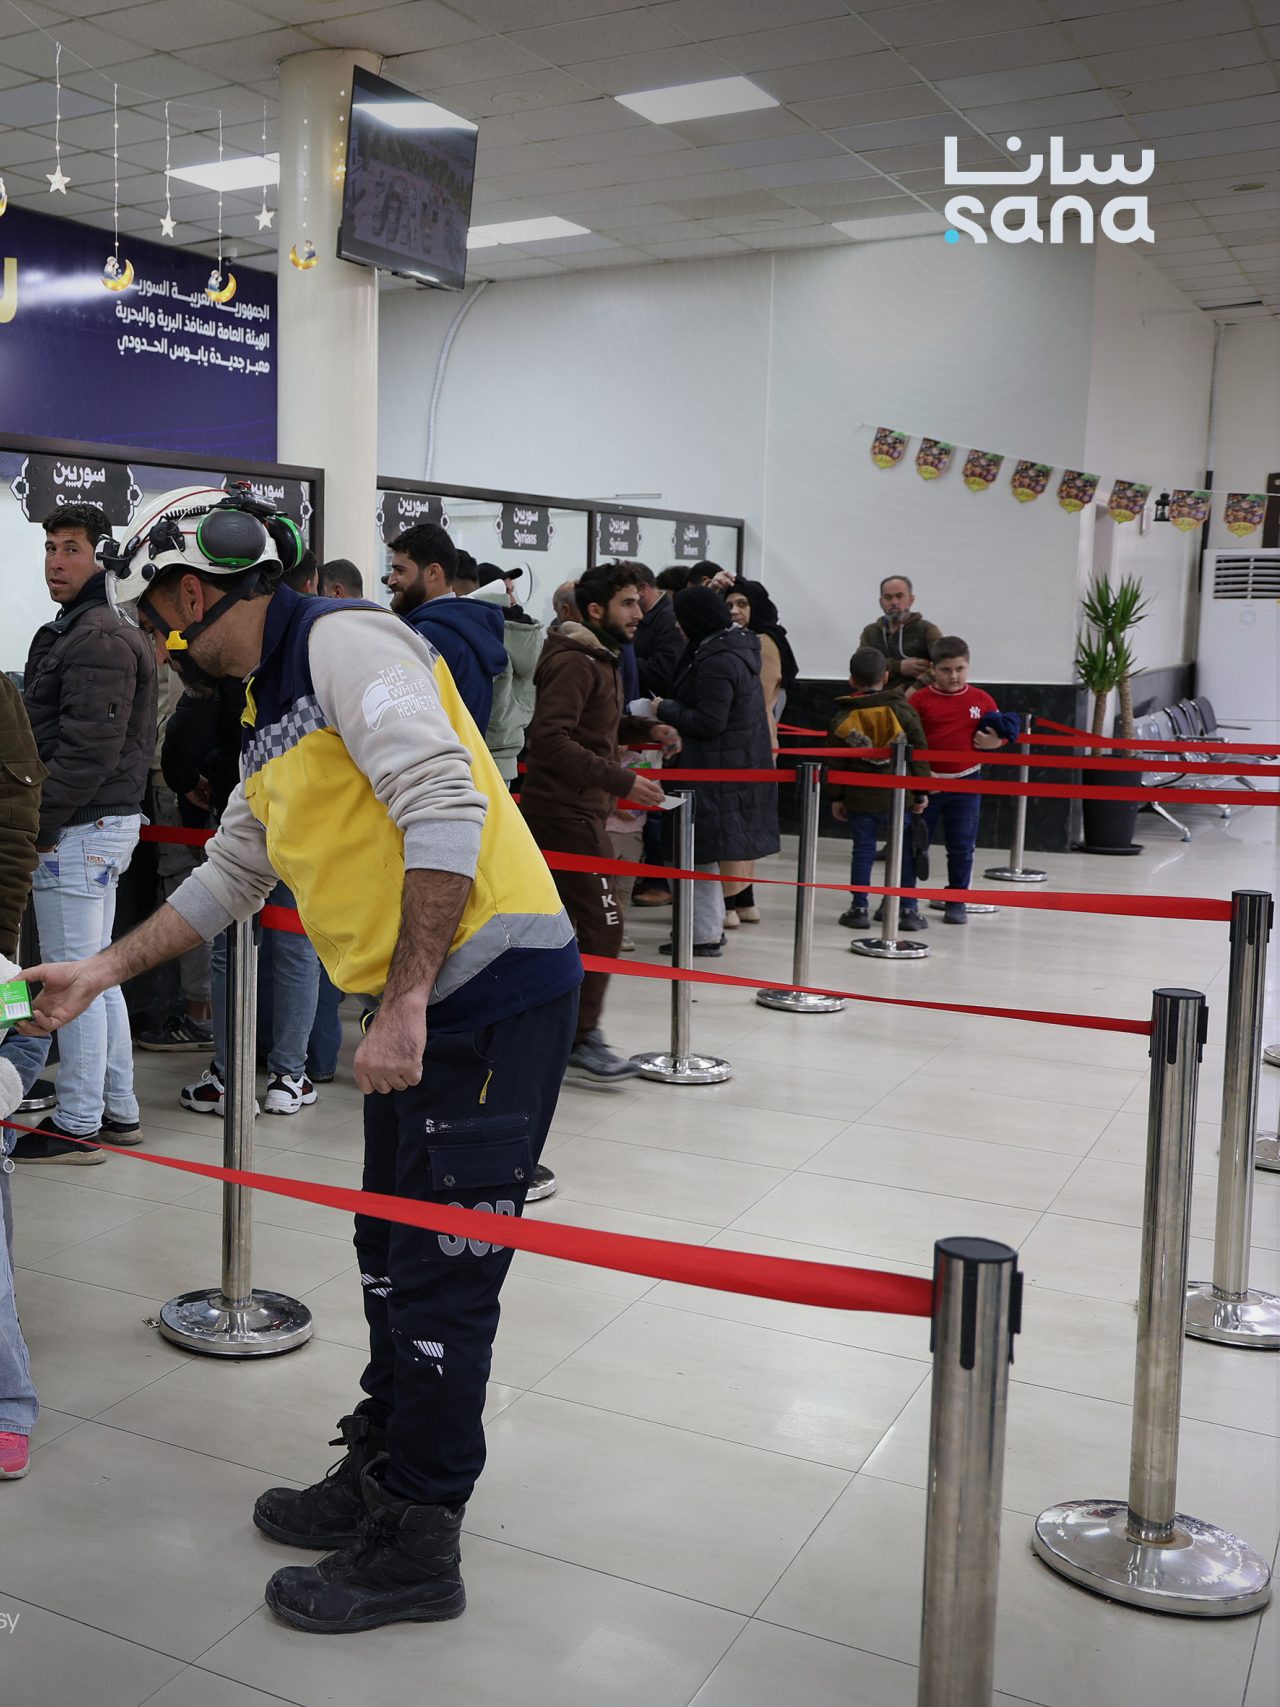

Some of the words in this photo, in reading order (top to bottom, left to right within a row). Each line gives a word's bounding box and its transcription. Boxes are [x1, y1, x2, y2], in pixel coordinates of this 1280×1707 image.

[115, 300, 156, 328] والبحرية
[157, 308, 183, 333] البرية
[183, 314, 216, 337] للمنافذ
[117, 333, 168, 355] الحدودي
[217, 322, 244, 344] العامة
[169, 343, 209, 366] يابوس
[209, 347, 245, 373] جديدة
[245, 359, 270, 376] معبر
[53, 461, 105, 489] سوريين
[398, 496, 429, 518] سوريين
[513, 529, 538, 547] Syrians
[378, 664, 407, 687] THE
[390, 680, 426, 698] WHITE
[592, 872, 620, 926] IKE
